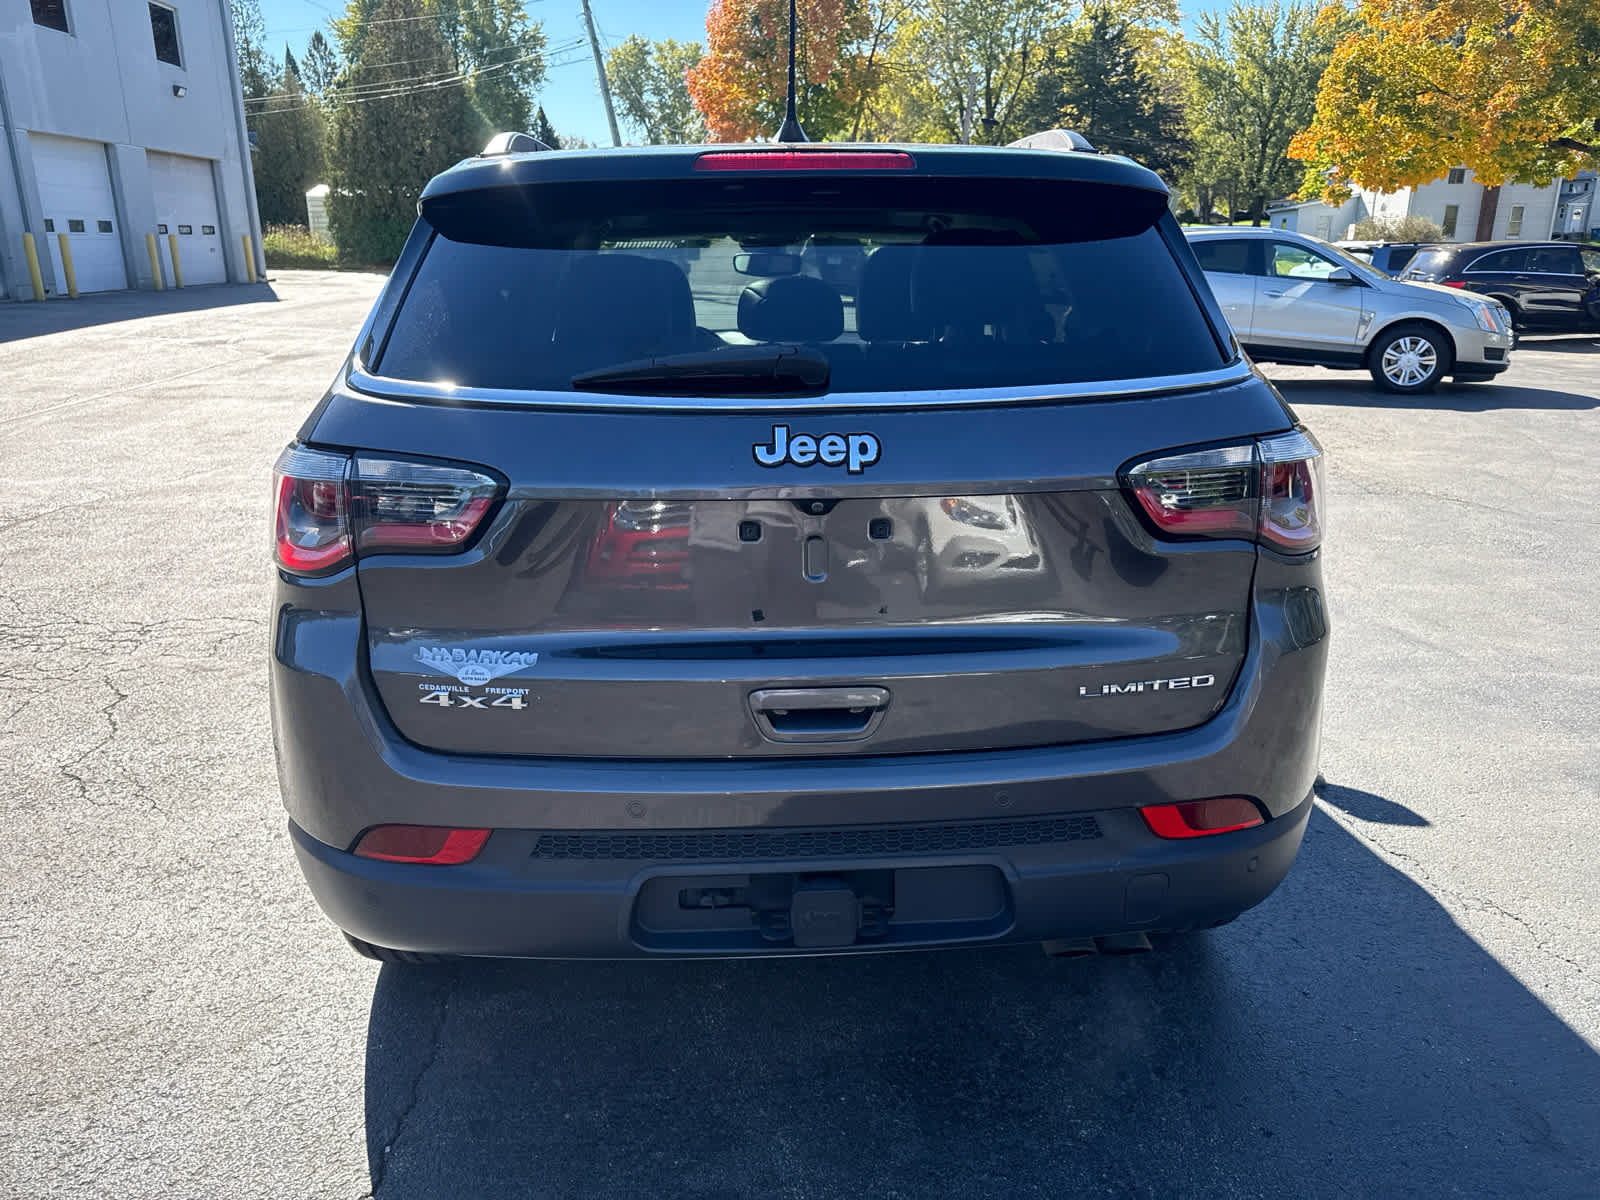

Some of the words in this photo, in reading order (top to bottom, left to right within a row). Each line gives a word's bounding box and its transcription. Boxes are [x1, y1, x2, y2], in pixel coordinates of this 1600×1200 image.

[753, 424, 881, 475] Jeep
[419, 683, 469, 693] CEDARVILLE
[485, 687, 530, 695] FREEPORT
[1079, 674, 1215, 697] LIMITED
